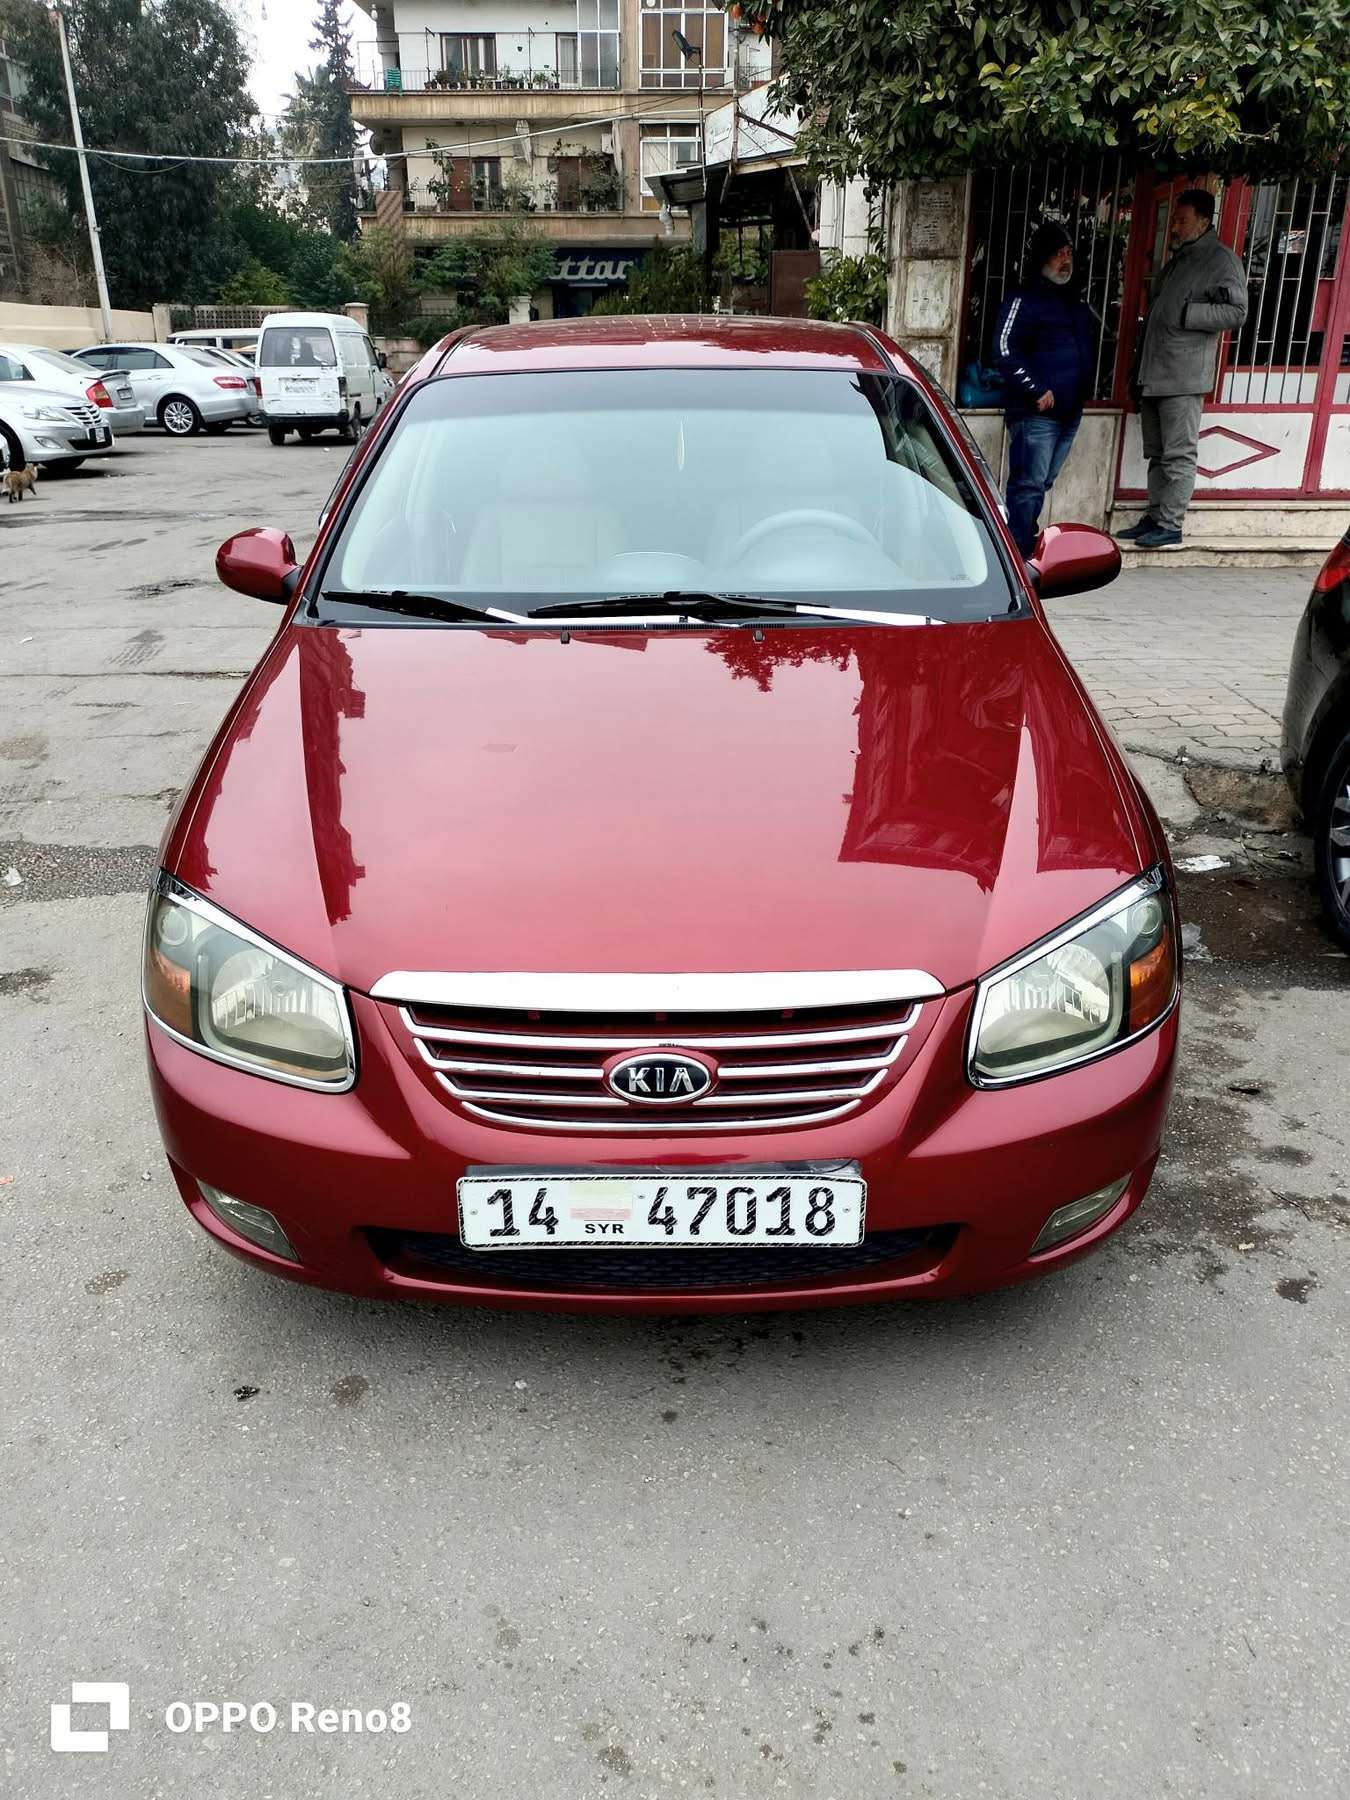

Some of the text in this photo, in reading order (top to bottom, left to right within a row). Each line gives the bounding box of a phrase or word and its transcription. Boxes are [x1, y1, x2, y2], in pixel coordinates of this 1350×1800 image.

[546, 255, 634, 280] ttar
[628, 1066, 695, 1093] KIA
[487, 1185, 837, 1237] 14 47018
[584, 1223, 625, 1234] SYR
